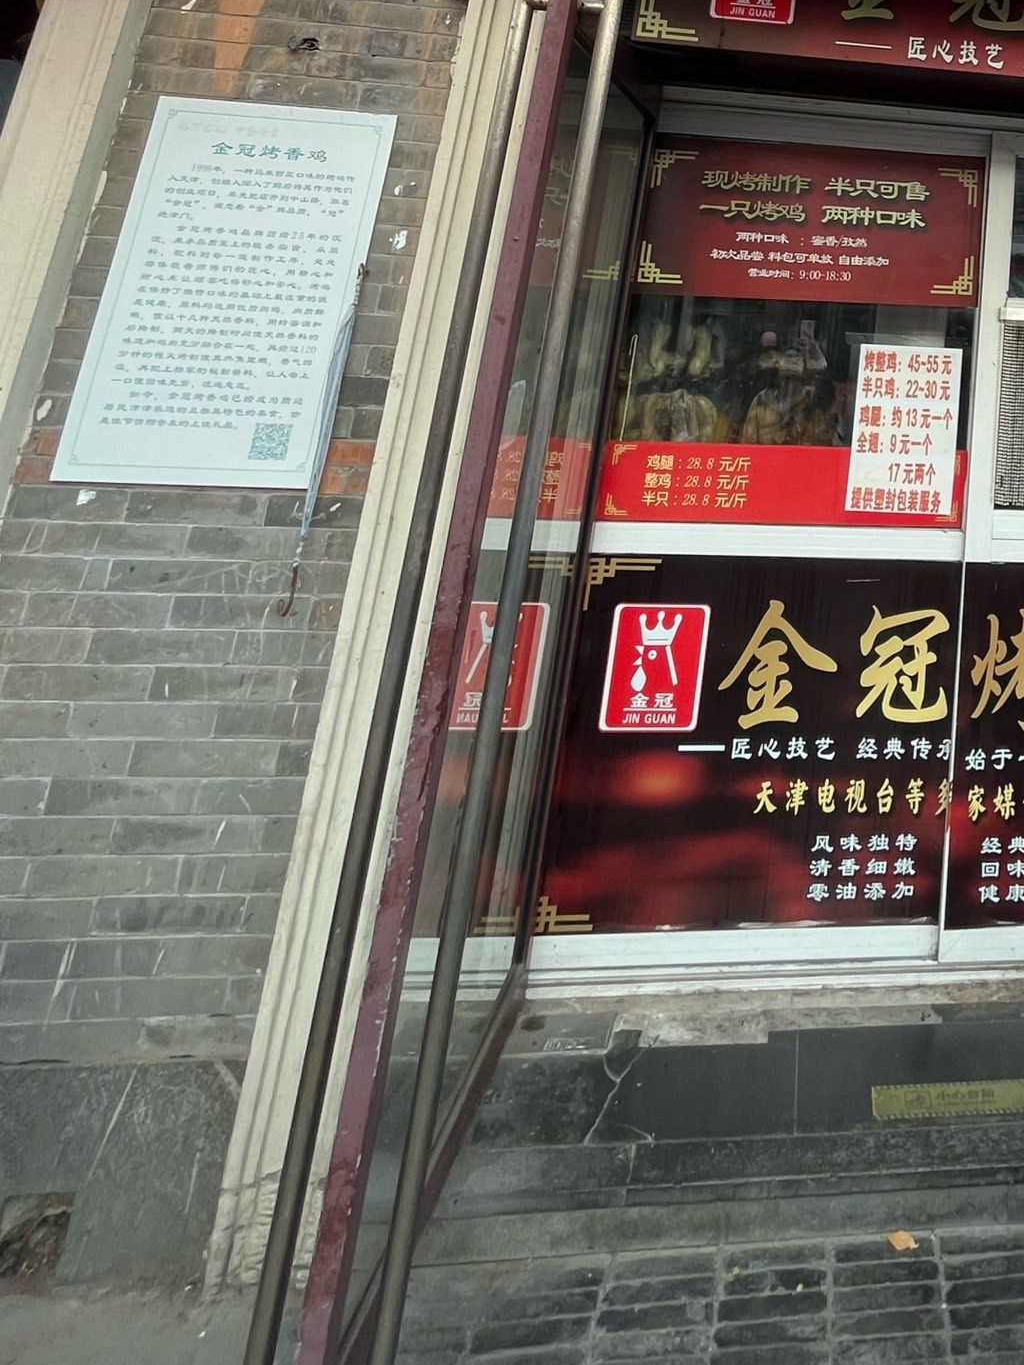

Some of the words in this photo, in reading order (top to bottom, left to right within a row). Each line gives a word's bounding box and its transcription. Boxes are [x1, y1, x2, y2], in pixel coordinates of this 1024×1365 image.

[729, 6, 745, 15] JIN
[748, 8, 776, 18] GUAN
[907, 36, 1004, 69] 匠心技艺
[210, 141, 328, 164] 金冠烤香鸡
[701, 170, 812, 195] 现烤制作
[824, 176, 931, 201] 半只可售
[699, 199, 807, 223] 一只烤鸡
[821, 205, 926, 229] 两种口味
[850, 485, 942, 513] 提供塑封包装服务
[629, 692, 675, 708] 金冠
[622, 713, 641, 724] JIN
[644, 713, 677, 724] GUAN
[730, 736, 836, 761] 匠心技艺
[811, 833, 918, 855] 风味独特
[808, 858, 917, 878] 清香细嫩
[806, 881, 915, 902] 零油添加
